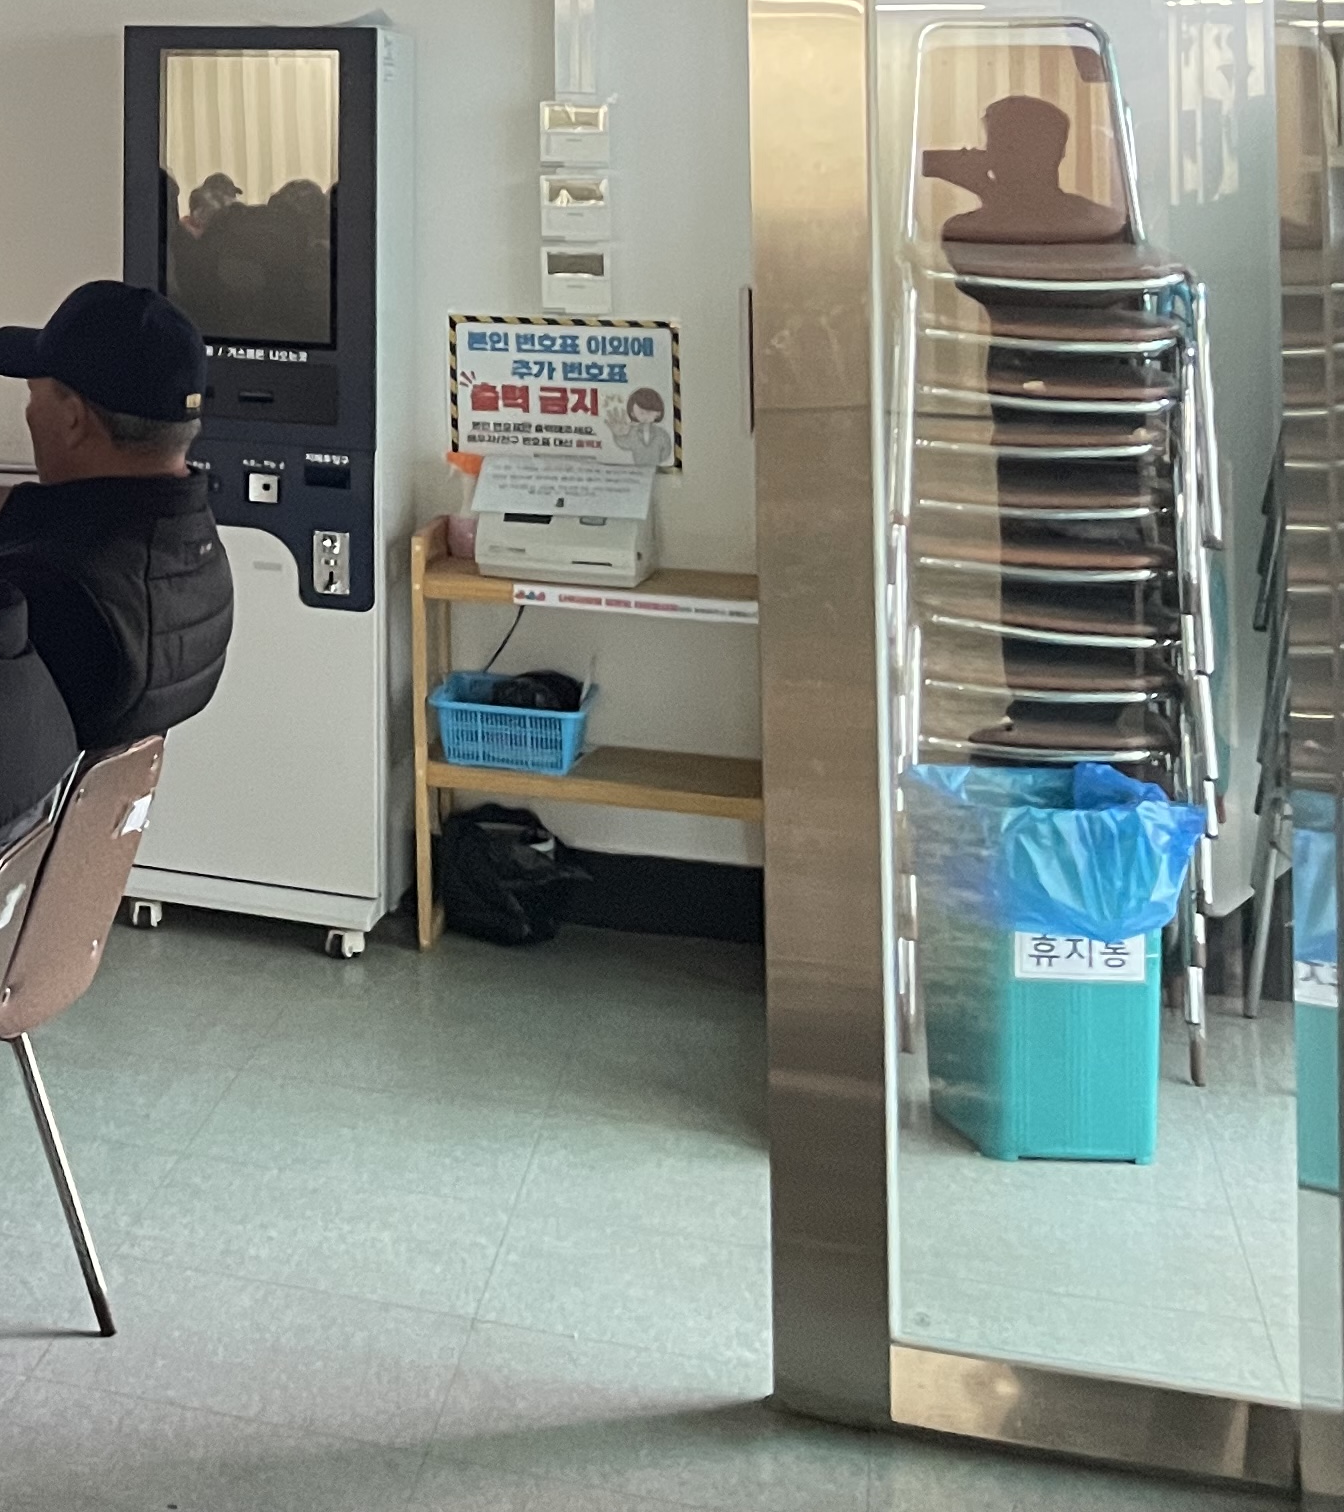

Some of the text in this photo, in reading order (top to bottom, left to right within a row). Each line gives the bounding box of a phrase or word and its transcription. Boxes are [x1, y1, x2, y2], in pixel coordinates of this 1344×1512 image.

[468, 331, 655, 357] 본인 번호표 이외에
[512, 359, 629, 384] 추가 번호표
[471, 382, 600, 417] 출력 금지
[1028, 933, 1131, 969] 휴지통
